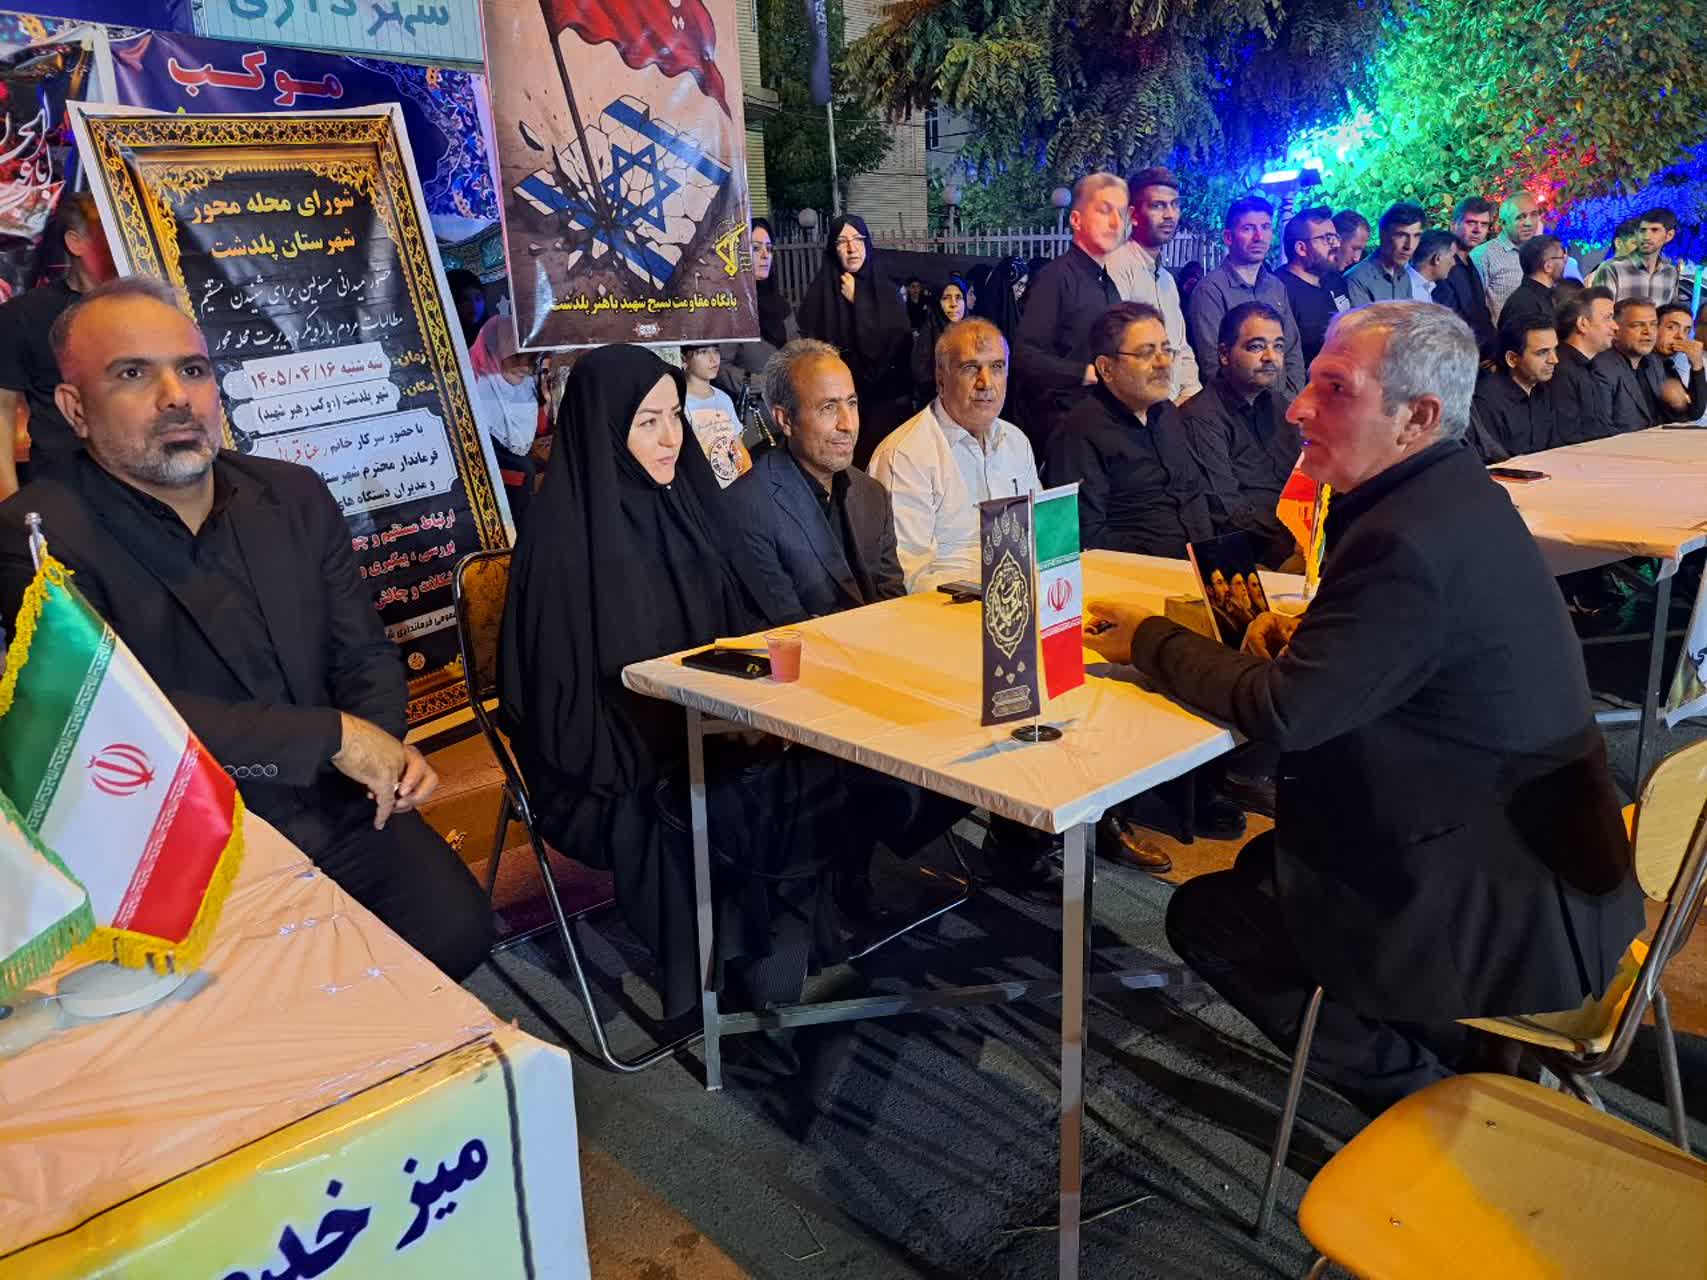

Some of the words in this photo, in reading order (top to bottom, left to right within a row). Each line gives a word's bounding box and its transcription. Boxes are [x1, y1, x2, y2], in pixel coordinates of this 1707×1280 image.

[167, 50, 345, 107] موکب
[191, 199, 242, 224] محور
[246, 191, 292, 213] محله
[297, 188, 354, 217] شورای
[210, 233, 279, 261] پلدشت
[336, 268, 366, 301] میدانی
[369, 269, 392, 289] حضور
[200, 278, 223, 319] مستقیم
[230, 274, 264, 314] شنیدن
[268, 284, 297, 305] برای
[620, 295, 646, 311] شهید
[672, 293, 710, 313] مقاومت
[710, 292, 738, 312] پایگاه
[551, 294, 590, 315] پلدشت
[592, 294, 619, 315] باهنر
[647, 297, 672, 312] بسیج
[336, 321, 359, 339] مردم
[360, 311, 404, 340] مطالبات
[216, 330, 232, 351] محور
[235, 329, 251, 349] محله
[340, 361, 365, 375] شنبه
[367, 361, 383, 370] سه
[393, 352, 427, 368] زمان:
[342, 389, 372, 406] پلدشت
[375, 387, 389, 404] شهر
[402, 381, 435, 396] مکان:
[289, 403, 310, 420] رهبر
[388, 428, 414, 444] حضور
[416, 423, 424, 434] با
[330, 438, 353, 454] خانم
[362, 459, 396, 480] محترم
[399, 448, 439, 472] فرماندار
[320, 464, 361, 485] شهرستا
[356, 486, 391, 504] دستگاه
[394, 480, 427, 498] مدیران
[429, 480, 436, 491] و
[420, 508, 457, 530] ارتباط
[371, 533, 381, 548] و
[381, 523, 420, 545] مستقیم
[411, 586, 420, 600] و
[396, 1138, 490, 1251] میز
